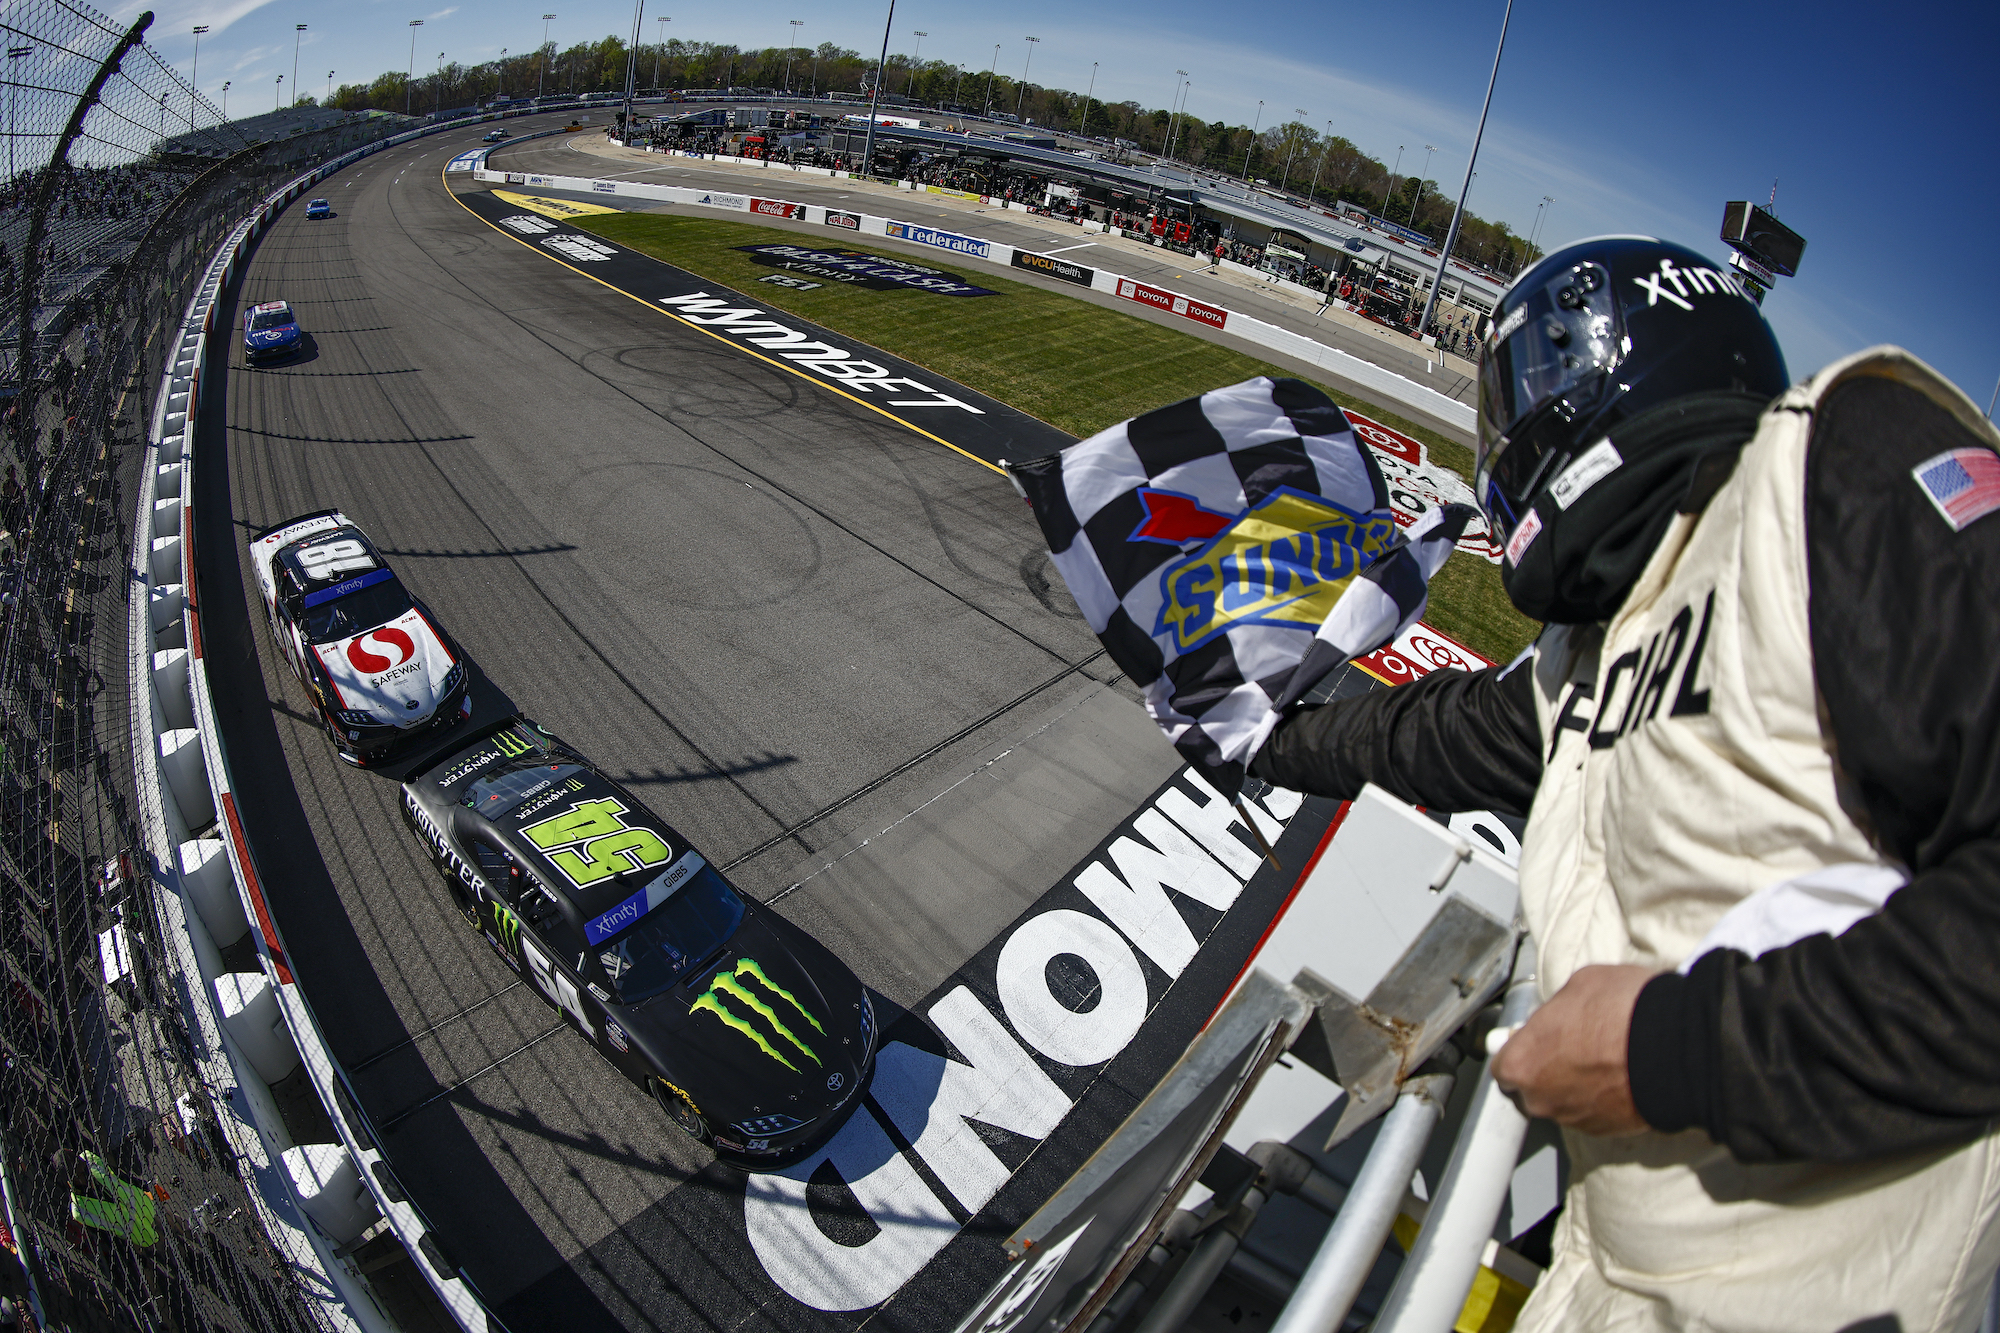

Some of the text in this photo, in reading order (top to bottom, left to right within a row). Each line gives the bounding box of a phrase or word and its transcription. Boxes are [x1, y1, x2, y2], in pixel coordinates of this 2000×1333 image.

[714, 195, 744, 206] RICHMOND
[757, 201, 785, 216] Coca-Cola
[907, 227, 990, 258] Federated
[759, 274, 824, 292] FS1
[867, 269, 973, 294] CASH
[1138, 288, 1224, 324] TOYOTA TOYOTA
[295, 539, 378, 581] 18
[335, 579, 364, 595] xfinity
[401, 615, 418, 624] ACME
[322, 645, 339, 655] ACME
[371, 661, 422, 689] SAFEWAY
[348, 730, 360, 741] 18
[444, 750, 486, 776] ENERGY
[520, 779, 552, 799] GIBBS
[517, 795, 672, 890] 54
[663, 865, 688, 888] GIBBS
[596, 901, 639, 935] xfinity
[520, 929, 600, 1045] 54
[747, 1138, 770, 1150] 54
